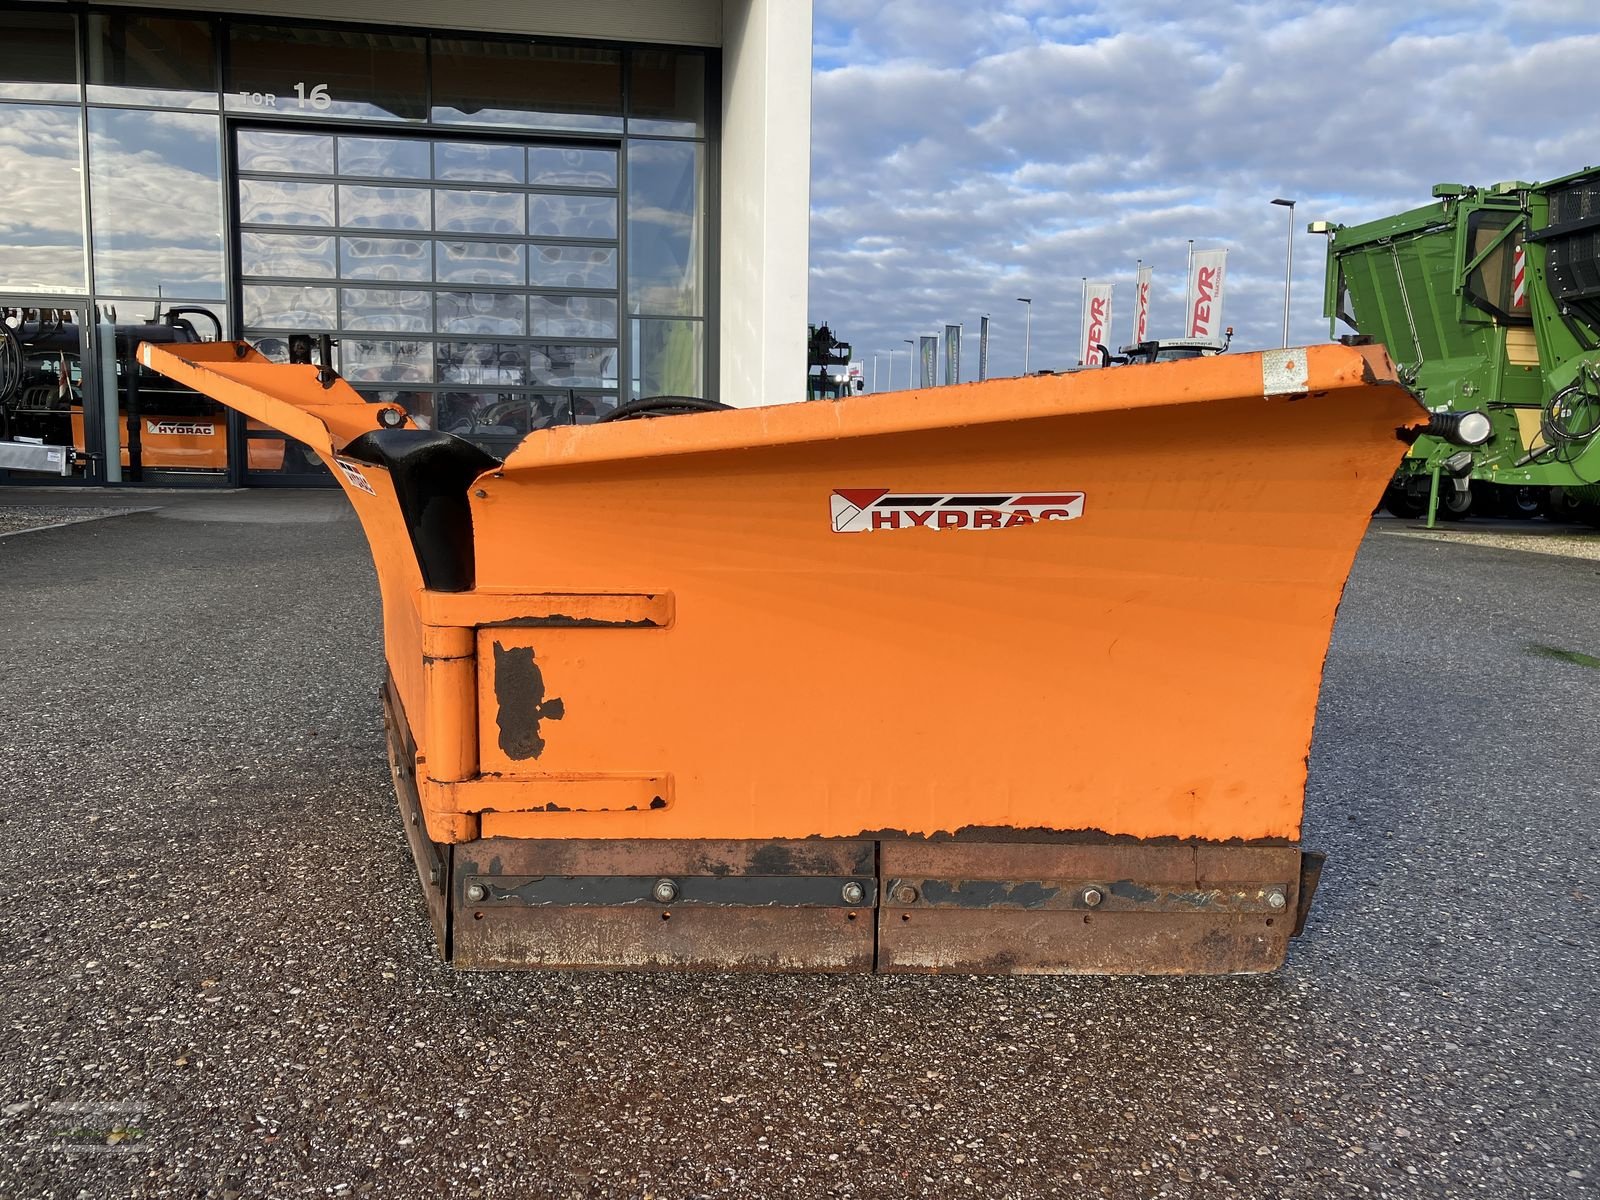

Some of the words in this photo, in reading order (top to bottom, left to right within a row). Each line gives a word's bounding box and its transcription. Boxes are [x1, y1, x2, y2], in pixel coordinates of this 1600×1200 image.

[239, 91, 276, 107] TOR
[293, 82, 332, 110] 16
[1138, 283, 1150, 343] TEYR
[1192, 266, 1216, 338] TEYR
[158, 425, 212, 435] HYDRAC
